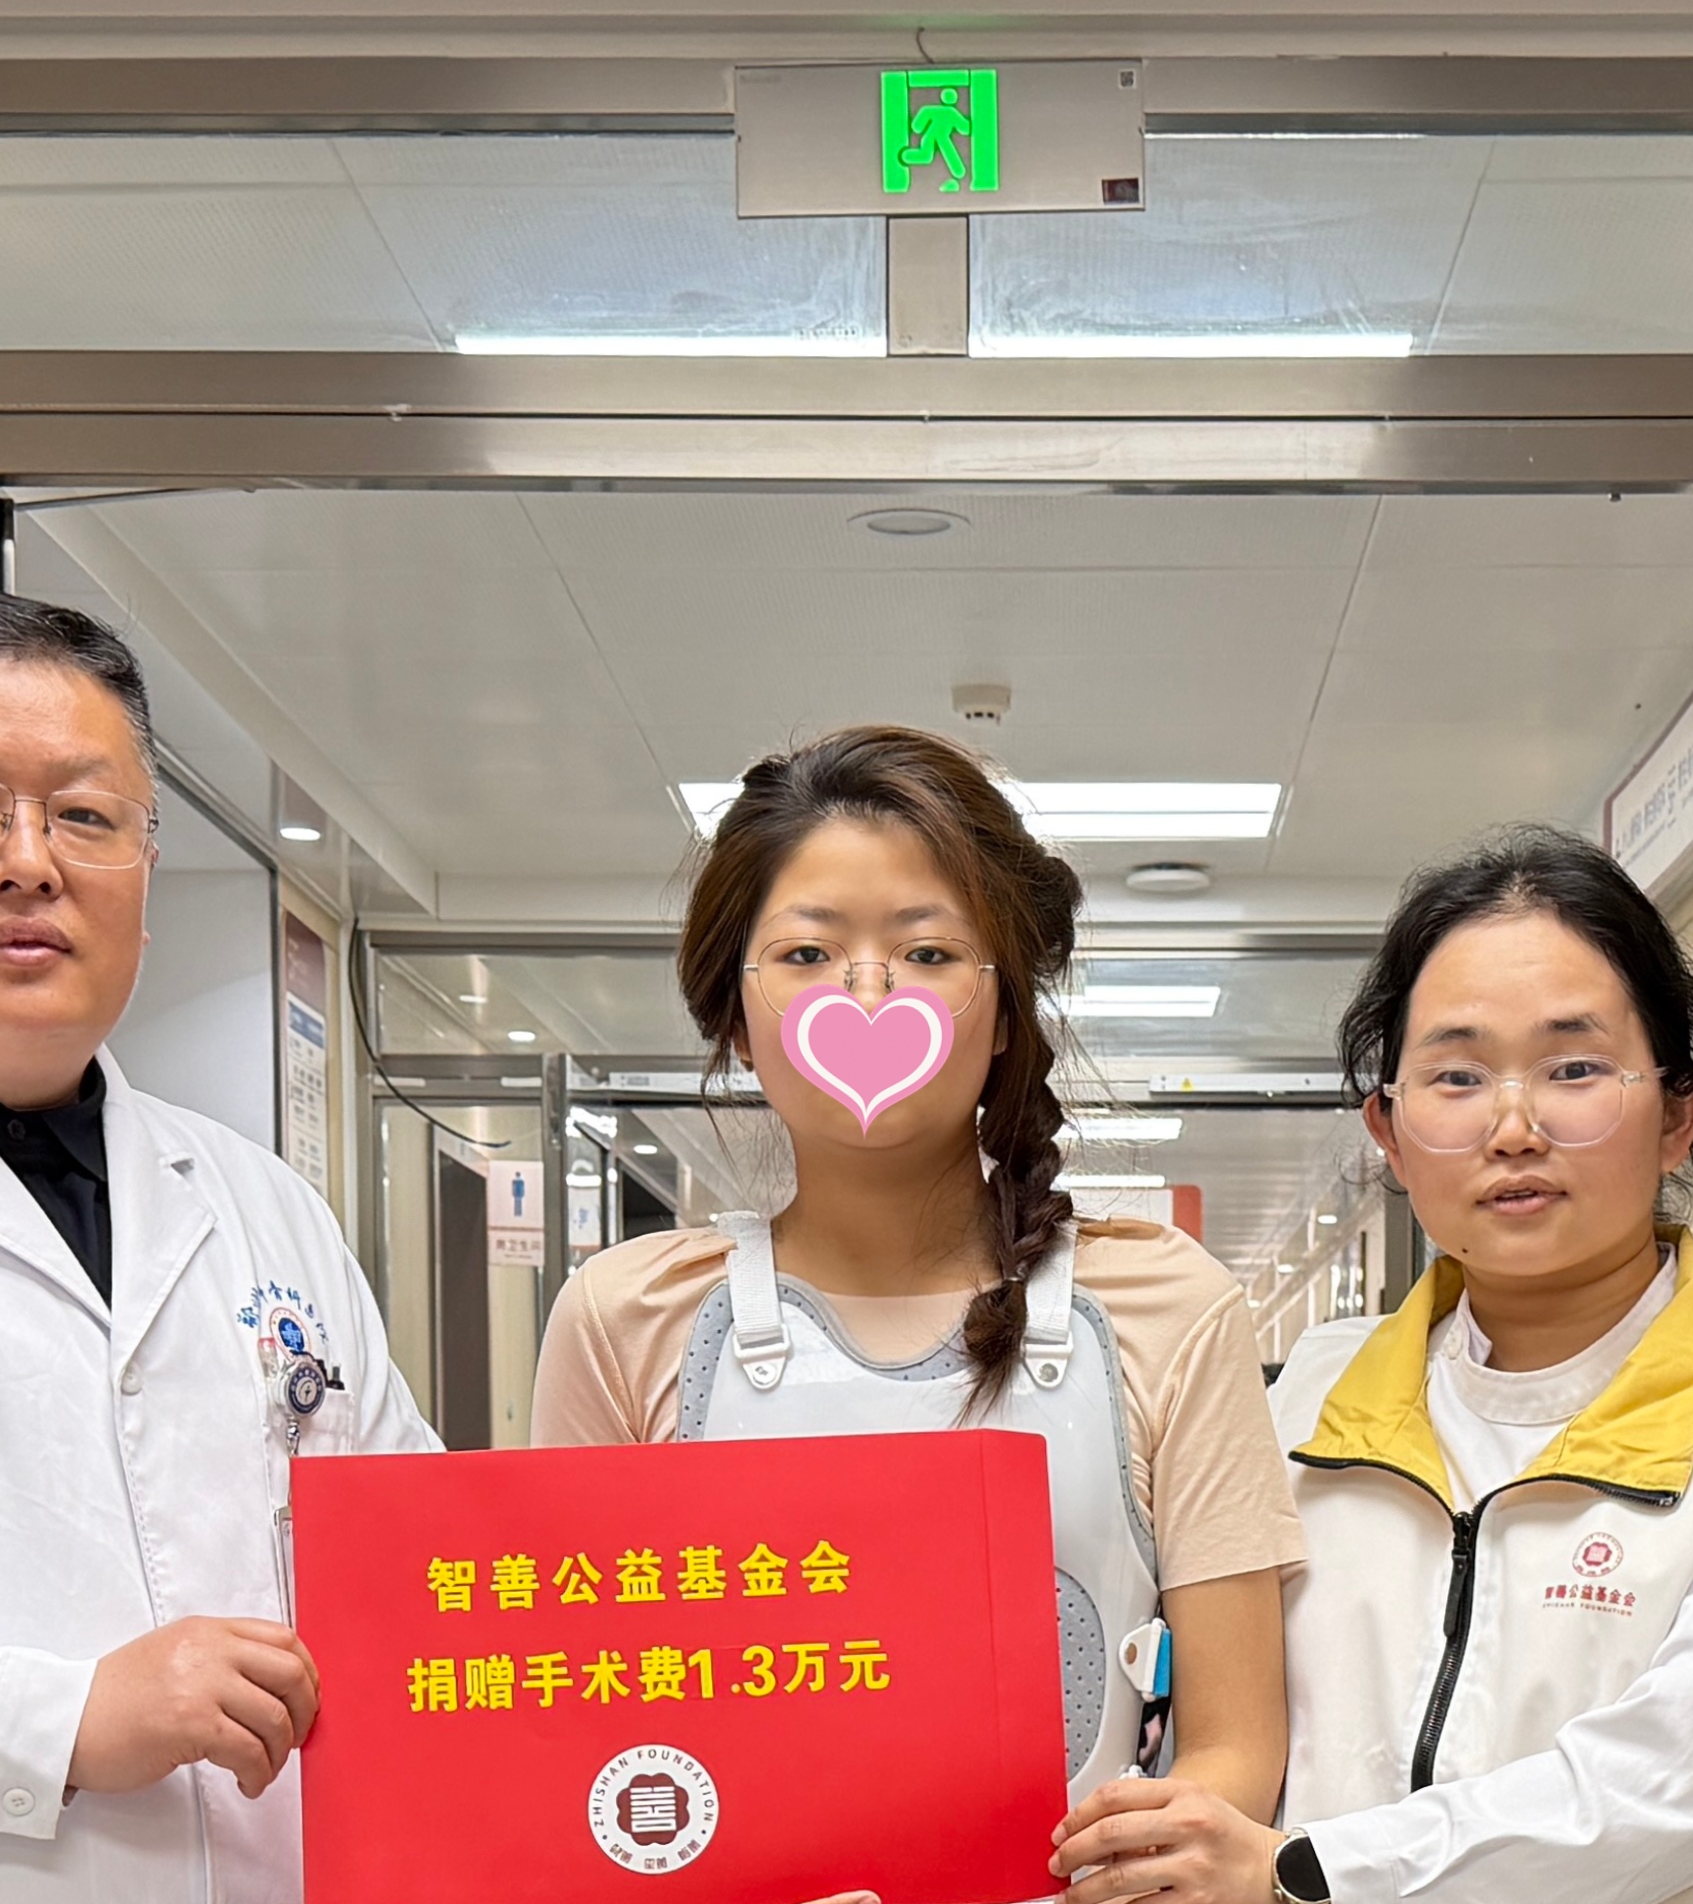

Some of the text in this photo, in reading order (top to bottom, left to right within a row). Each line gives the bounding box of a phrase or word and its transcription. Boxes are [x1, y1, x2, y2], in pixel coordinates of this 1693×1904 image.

[428, 1540, 851, 1613] 智善公益基金会
[407, 1639, 891, 1713] 捐赠手术费1.3万元
[592, 1749, 715, 1827] ZHISHAN FOUNDATION
